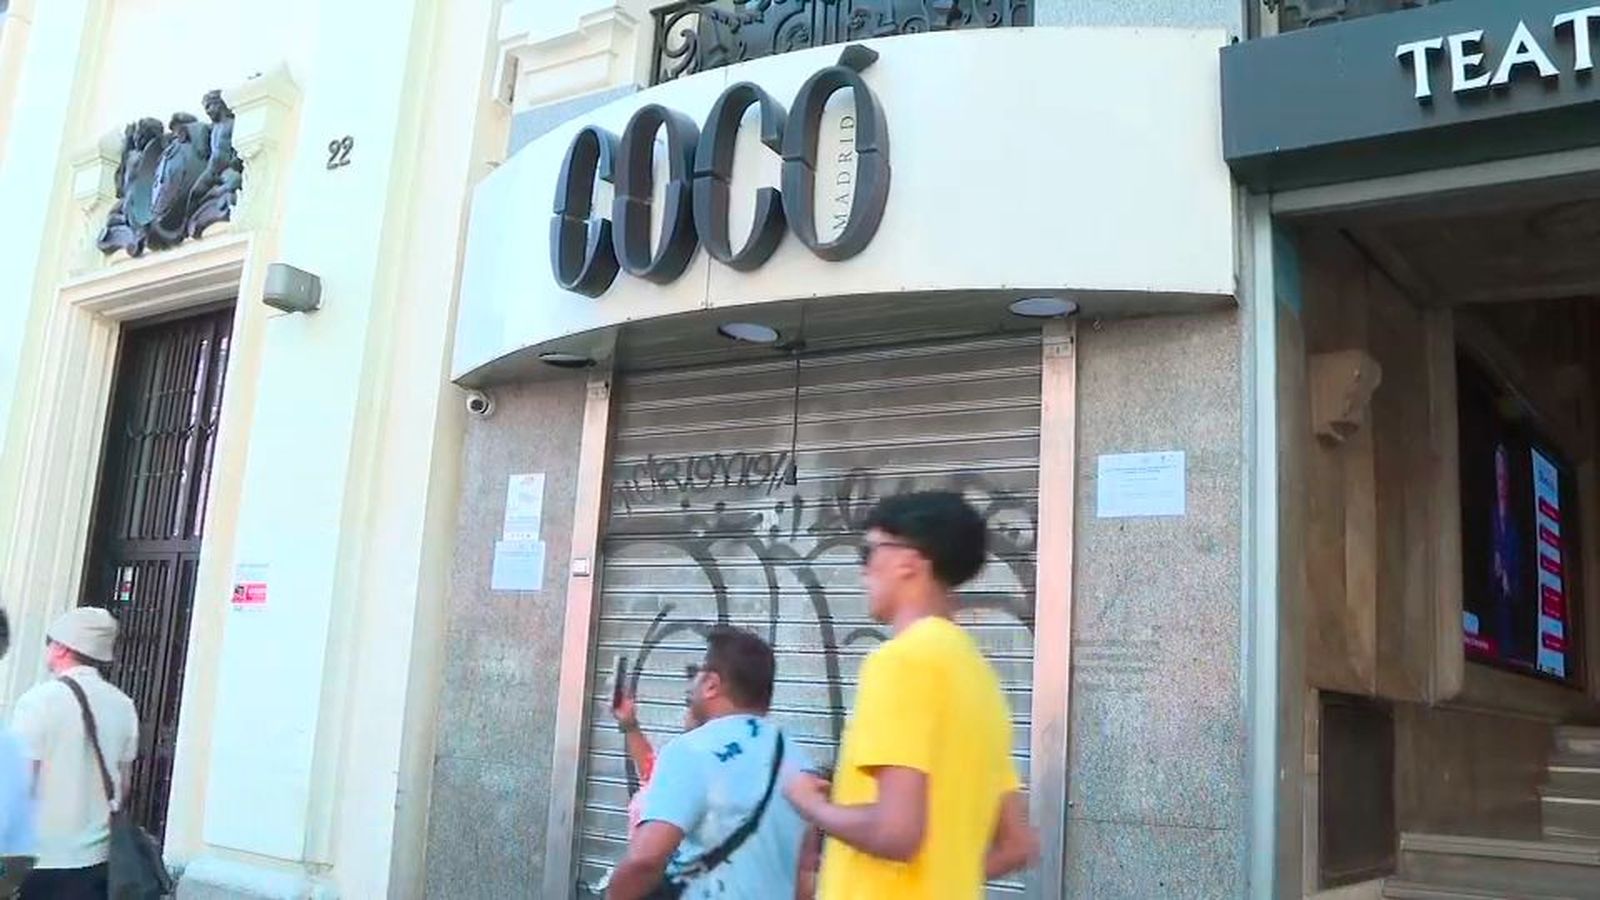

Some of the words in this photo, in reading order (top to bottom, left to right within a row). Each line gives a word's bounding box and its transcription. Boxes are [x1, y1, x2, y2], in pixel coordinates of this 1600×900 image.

[1395, 6, 1600, 98] TEAT
[326, 135, 354, 170] 22
[550, 44, 892, 299] COCÓ
[833, 115, 855, 230] MADRID
